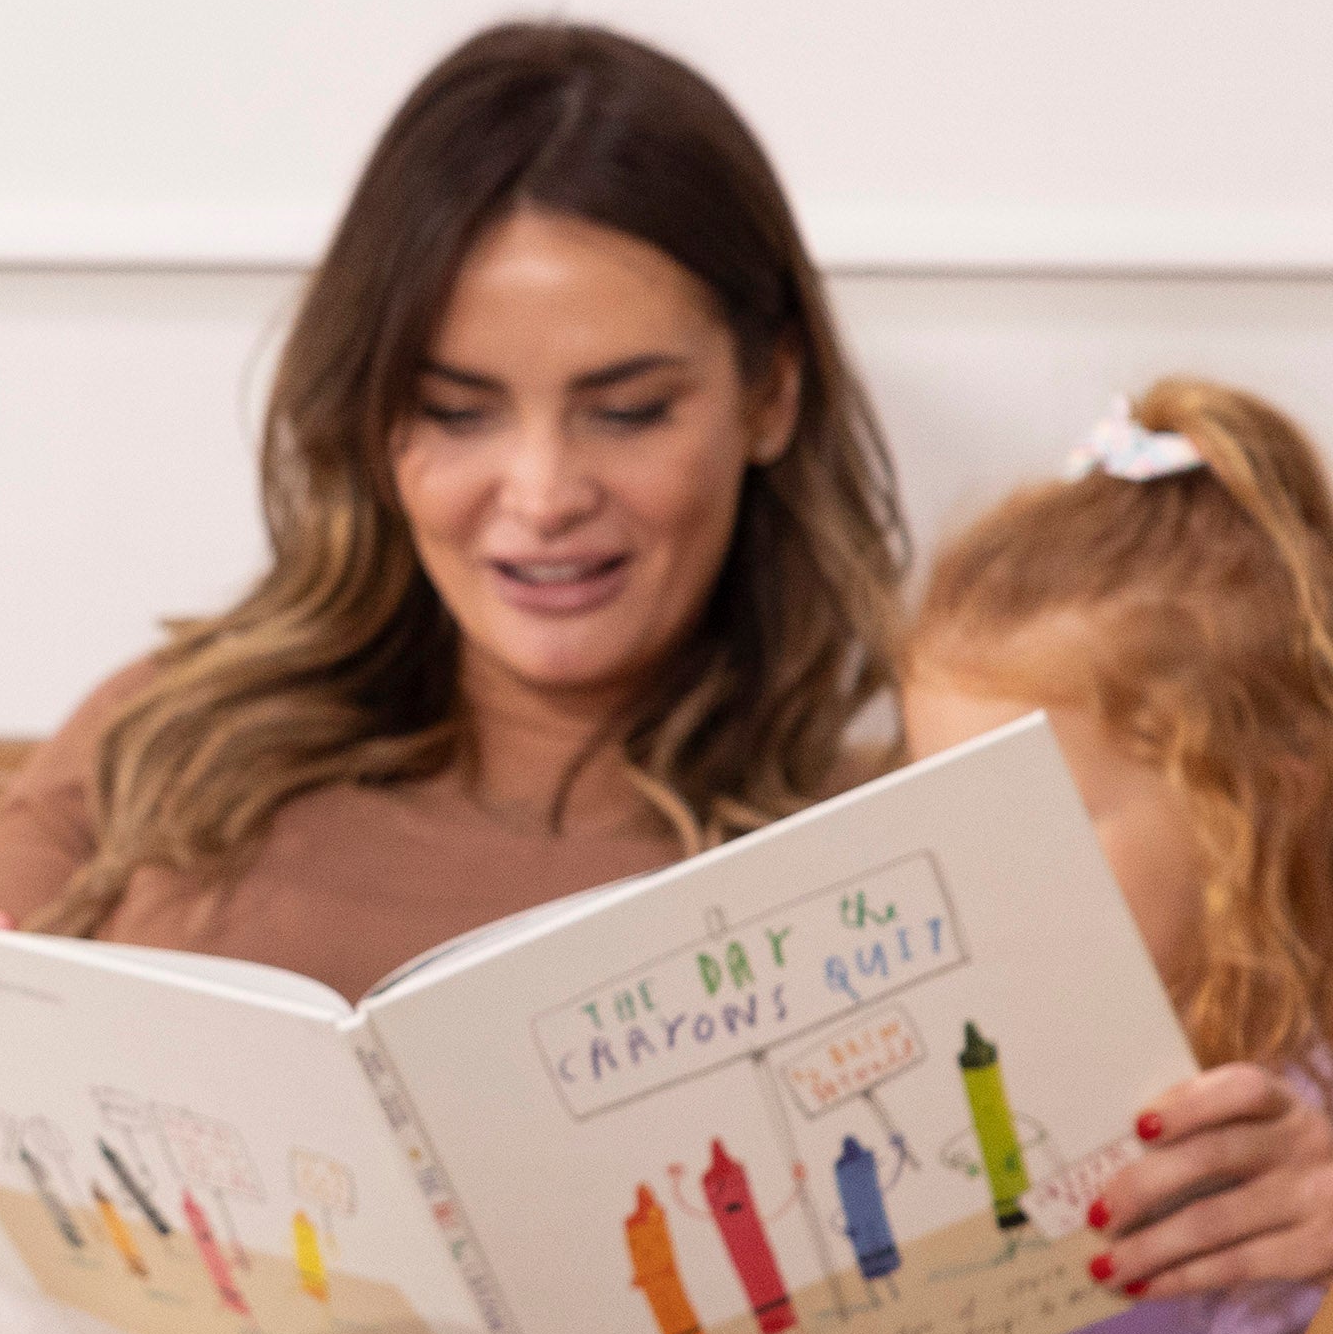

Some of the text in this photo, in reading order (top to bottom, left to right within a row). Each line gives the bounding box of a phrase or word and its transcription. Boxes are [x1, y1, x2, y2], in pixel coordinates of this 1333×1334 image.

[581, 890, 898, 1030] THE DAY the
[824, 916, 943, 1004] QUIT
